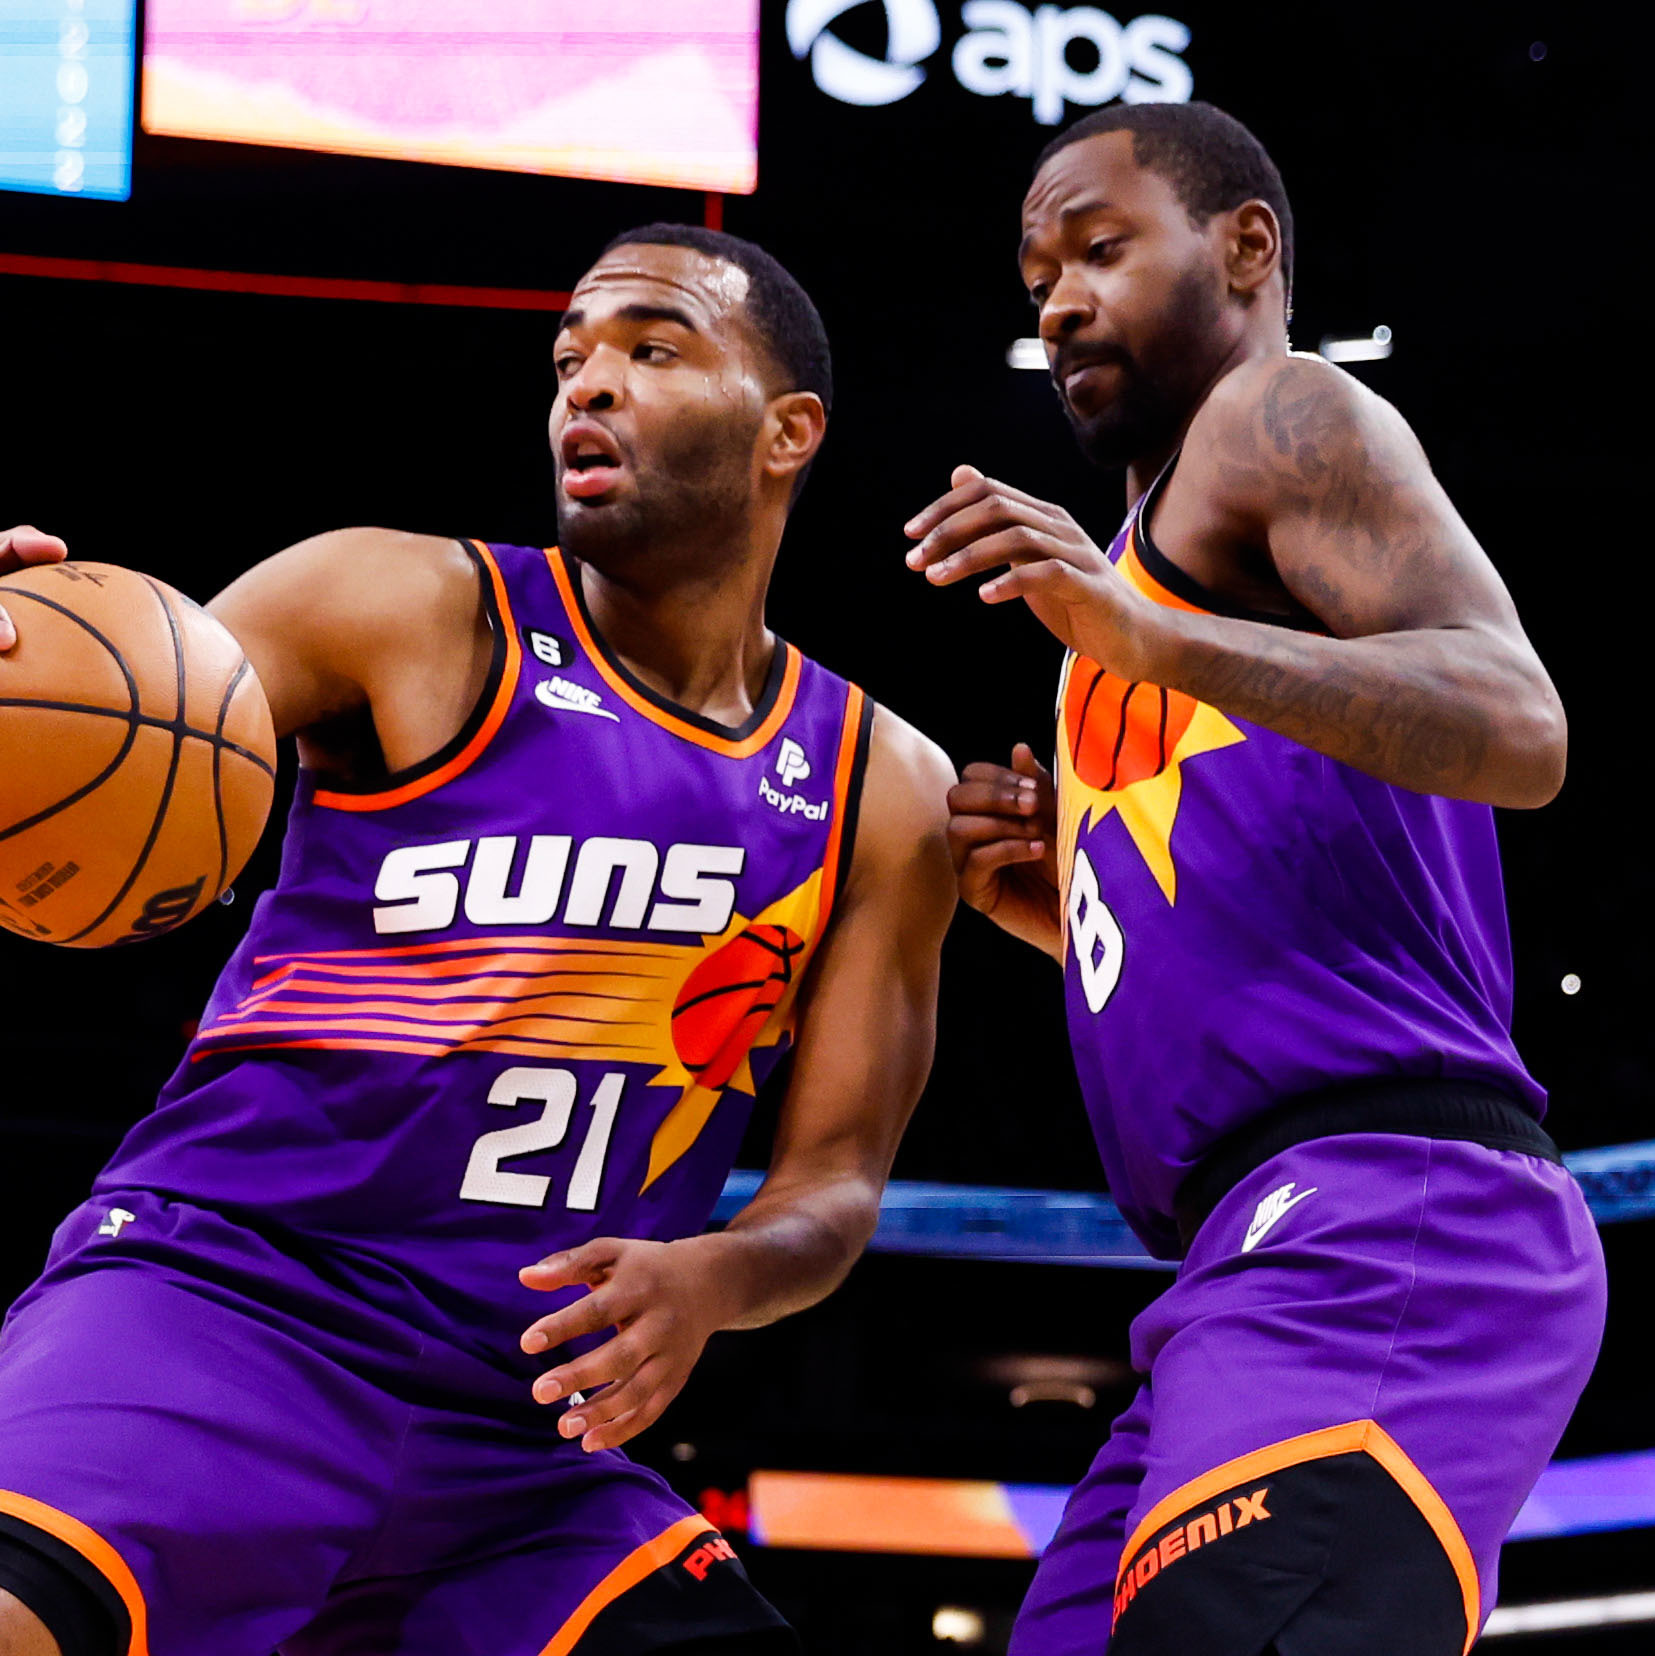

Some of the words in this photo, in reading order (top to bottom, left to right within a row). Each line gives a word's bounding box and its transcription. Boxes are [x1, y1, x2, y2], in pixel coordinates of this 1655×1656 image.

[951, 0, 1194, 125] aps
[530, 631, 562, 666] 6
[547, 675, 602, 707] NIKE
[758, 776, 829, 821] PayPal
[372, 834, 745, 934] SUNS
[459, 1066, 627, 1211] 21
